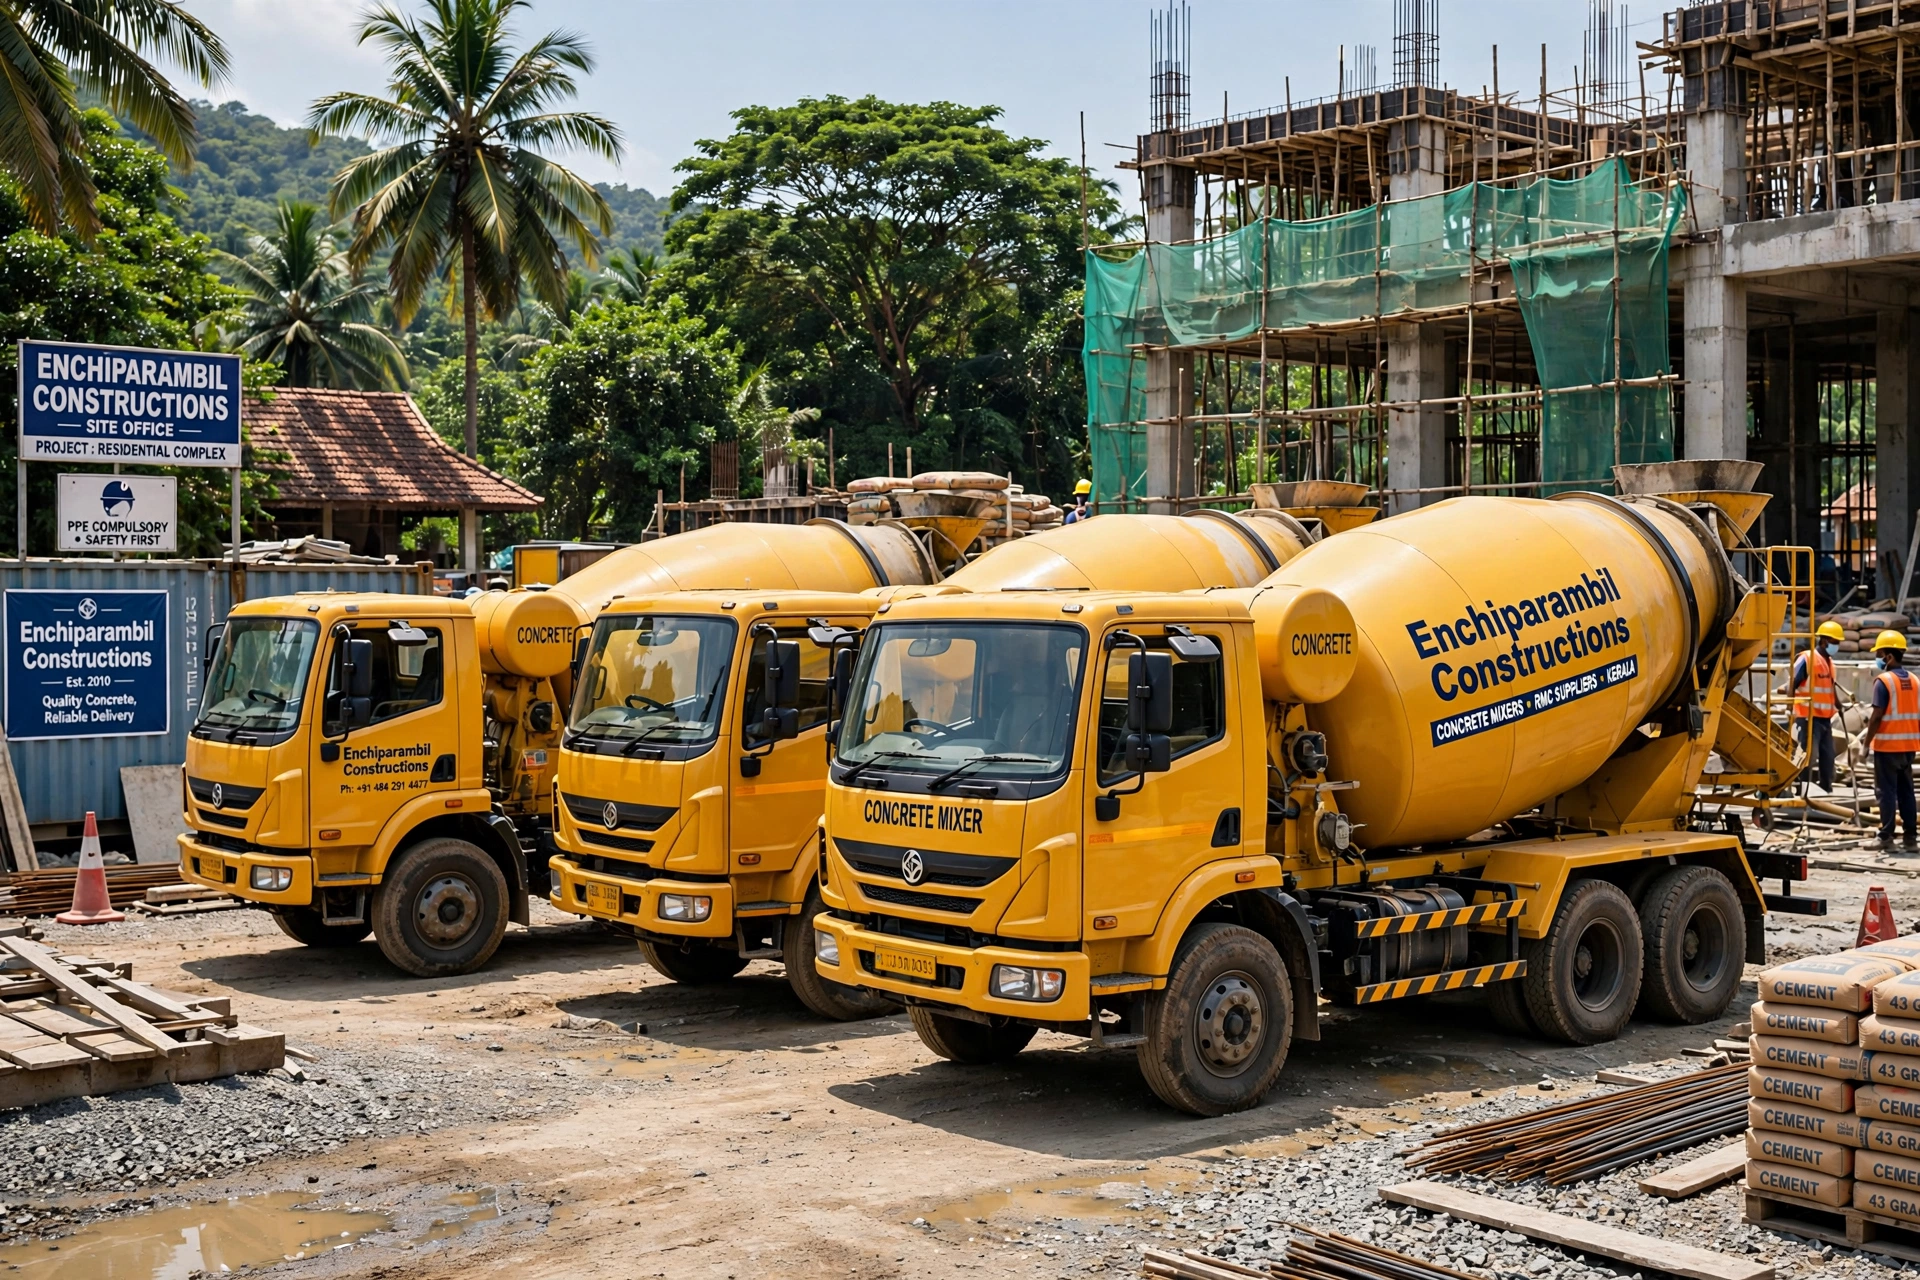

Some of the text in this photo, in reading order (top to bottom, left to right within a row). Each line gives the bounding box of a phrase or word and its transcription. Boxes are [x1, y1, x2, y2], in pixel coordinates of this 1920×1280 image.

[37, 352, 228, 390] ENCHIPARAMBIL
[32, 384, 229, 421] CONSTRUCTIONS
[86, 419, 174, 437] SITE OFFICE
[36, 440, 89, 454] PROJECT
[98, 443, 170, 458] RESIDENTIAL
[173, 445, 226, 460] COMPLEX
[68, 521, 169, 533] PPE COMPULSORY
[85, 535, 160, 545] SAFETY FIRST
[1405, 567, 1621, 660] Enchiparambil
[20, 620, 154, 647] Enchiparambil
[517, 626, 573, 644] CONCRETE
[1292, 633, 1351, 656] CONCRETE
[23, 646, 152, 669] Constructions
[1431, 616, 1630, 701] Constructions
[66, 675, 111, 687] Est. 2010
[42, 693, 137, 709] Quality Concrete,
[1436, 659, 1635, 740] CONCRETE MIXERS RMC SUPPLIERS KERALA
[44, 709, 134, 724] Reliable Delivery
[343, 743, 431, 762] Enchiparambil
[343, 760, 429, 776] Constructions
[340, 780, 428, 794] Ph: +91 484 291 4477
[864, 799, 983, 834] CONCRETE MIXER
[1774, 981, 1837, 1001] CEMENT
[1889, 995, 1908, 1011] 43
[1766, 1014, 1828, 1034] CEMENT
[1879, 1029, 1896, 1044] 43
[1766, 1046, 1829, 1069] CEMENT
[1878, 1063, 1896, 1078] 43
[1763, 1076, 1823, 1101] CEMENT
[1764, 1109, 1825, 1133] CEMENT
[1875, 1130, 1893, 1146] 43
[1762, 1140, 1823, 1165] CEMENT
[1759, 1170, 1819, 1196] CEMENT
[1869, 1194, 1920, 1217] 43 GRA
